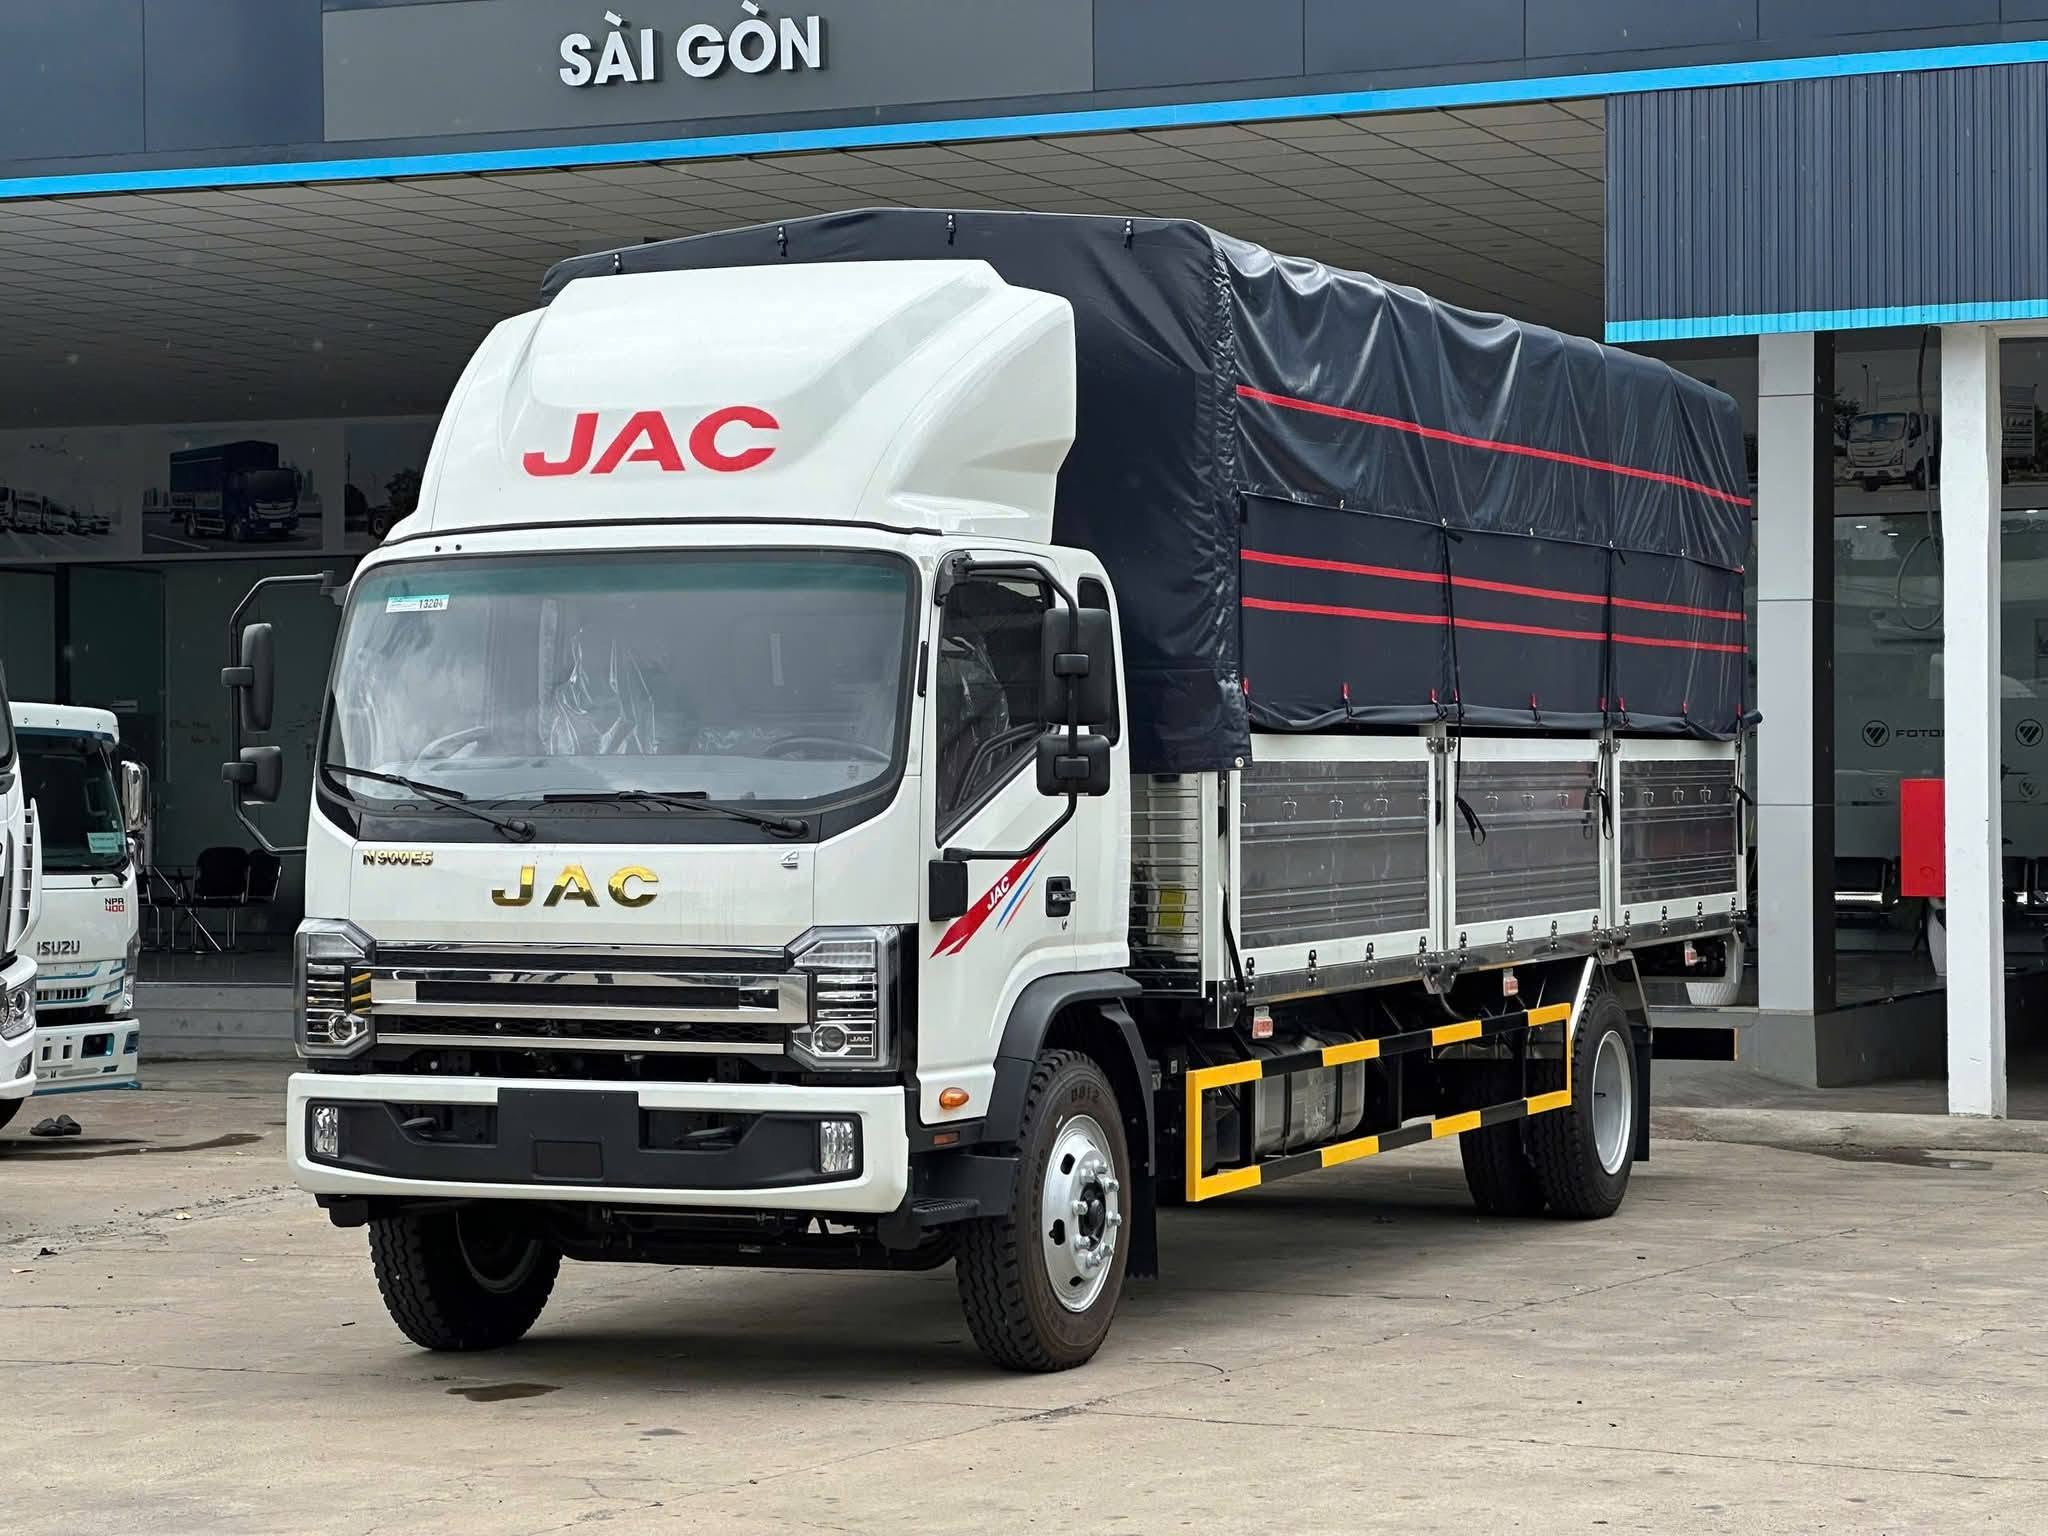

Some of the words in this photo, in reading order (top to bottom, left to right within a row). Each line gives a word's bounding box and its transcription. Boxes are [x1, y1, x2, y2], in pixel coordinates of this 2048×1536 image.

[559, 10, 655, 87] SÀI
[676, 0, 821, 78] GÒN
[522, 405, 780, 477] JAC
[363, 849, 434, 866] N900E5
[104, 897, 125, 905] NPR
[491, 863, 659, 908] JAC
[986, 875, 1010, 911] JAC
[36, 940, 81, 956] ISUZU
